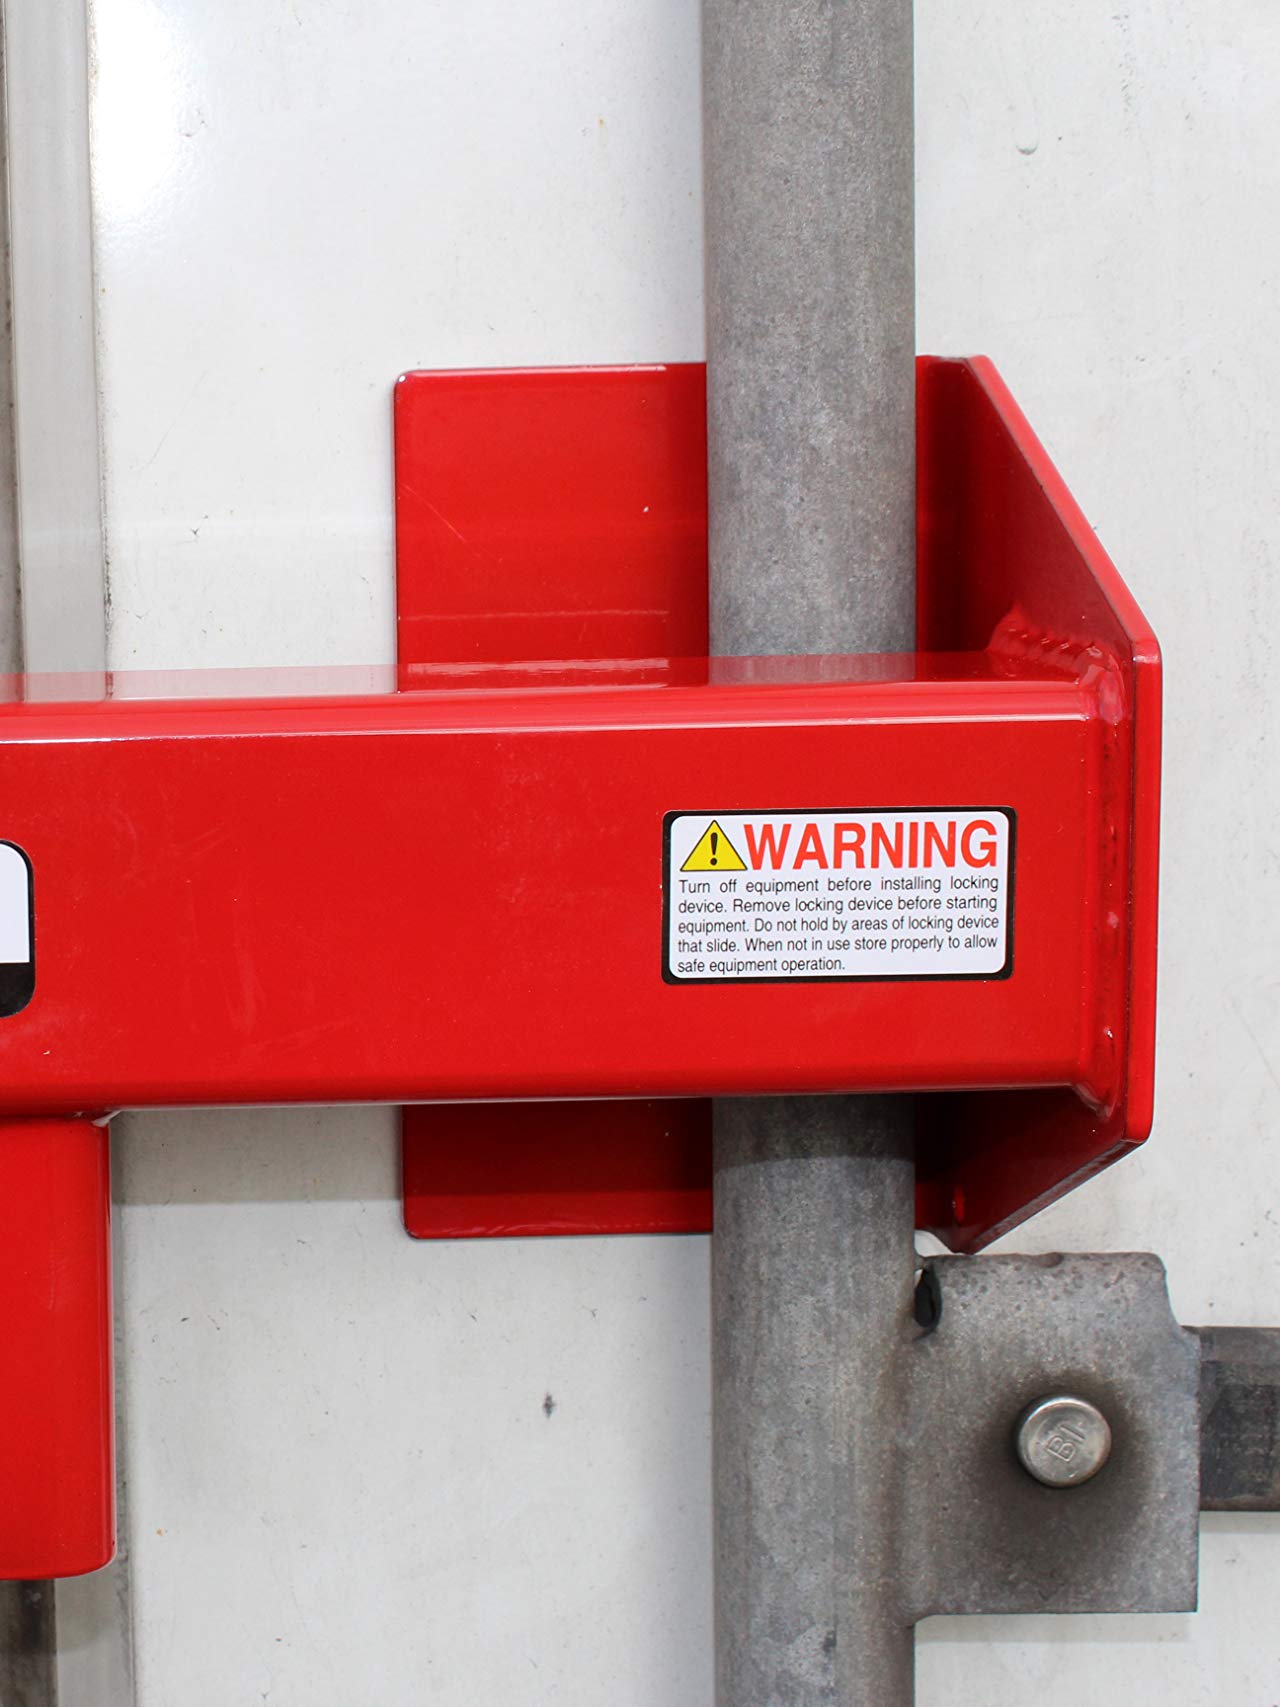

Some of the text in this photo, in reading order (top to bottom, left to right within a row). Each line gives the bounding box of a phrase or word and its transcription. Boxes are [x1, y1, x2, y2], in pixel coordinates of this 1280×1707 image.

[744, 820, 997, 871] WARNING
[680, 876, 998, 893] Turn off equipment before installing locking
[679, 897, 997, 914] device. Remove locking device before starting
[679, 916, 999, 935] equipment. Do not hold by areas of locking device
[678, 936, 997, 952] that slide. When not in use store properly to allow
[678, 958, 845, 975] safe equipment operation.
